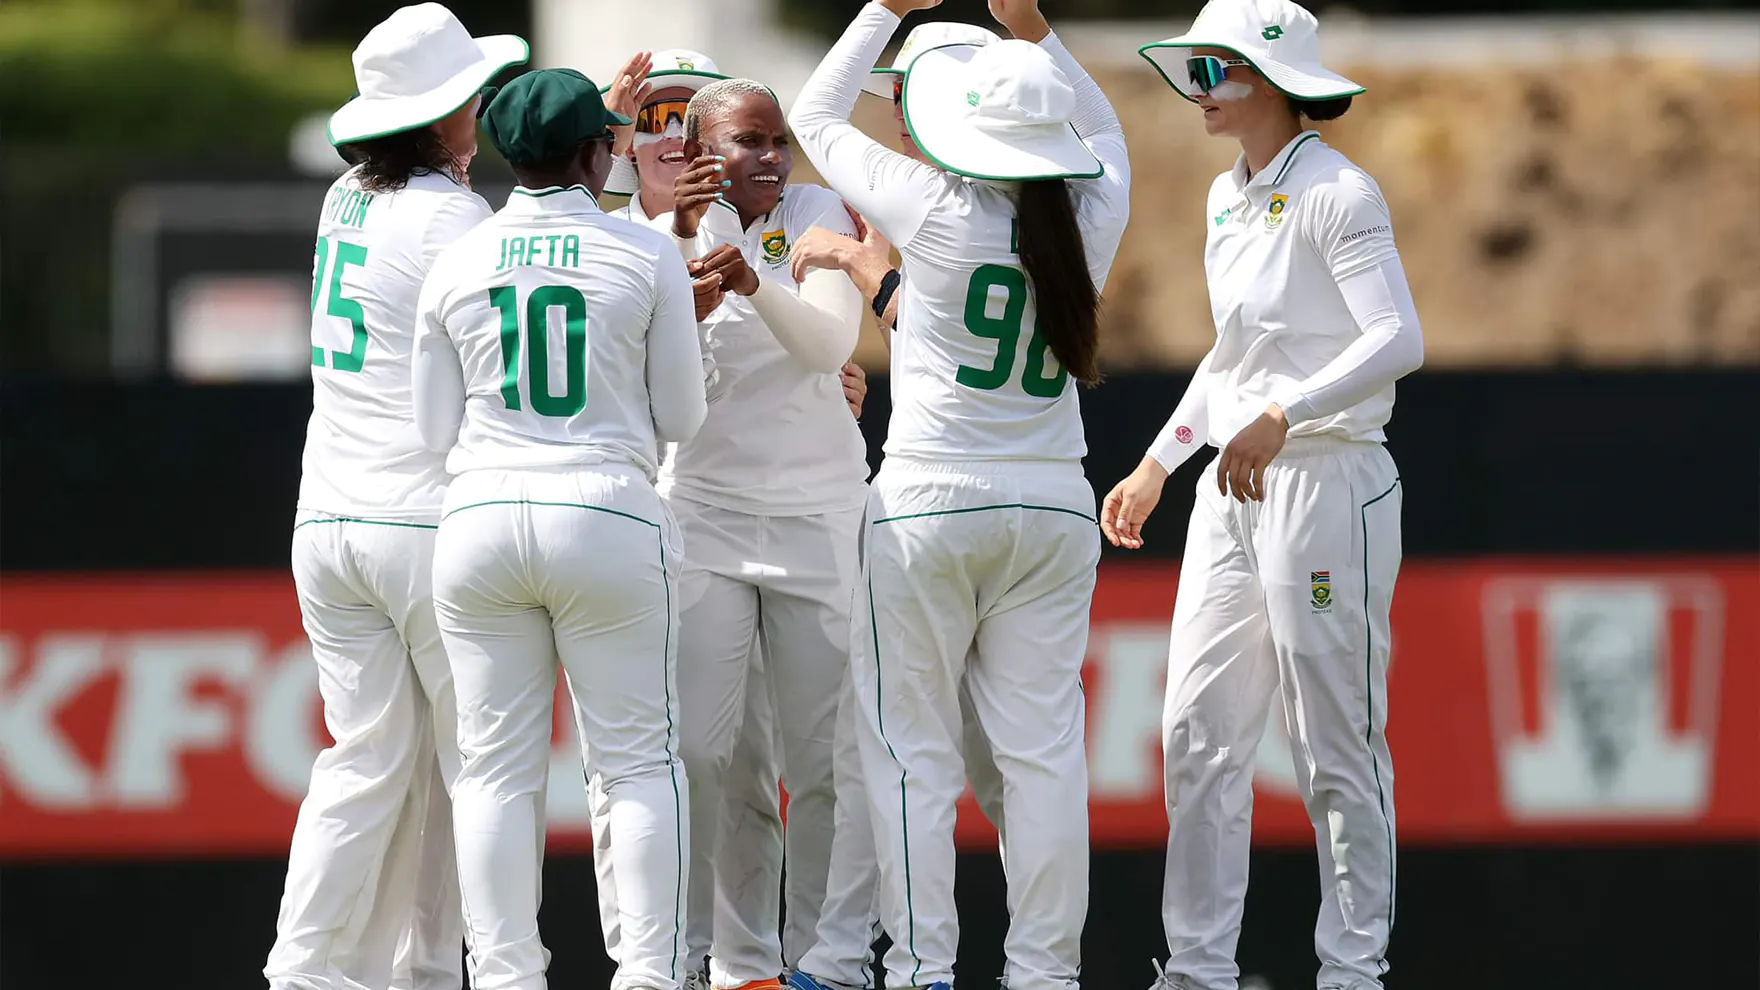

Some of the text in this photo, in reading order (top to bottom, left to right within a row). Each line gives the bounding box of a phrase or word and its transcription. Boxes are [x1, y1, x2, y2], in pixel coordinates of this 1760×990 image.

[325, 186, 375, 228] RYON
[496, 235, 579, 270] JAFTA
[311, 236, 368, 373] 25
[489, 285, 587, 417] 10
